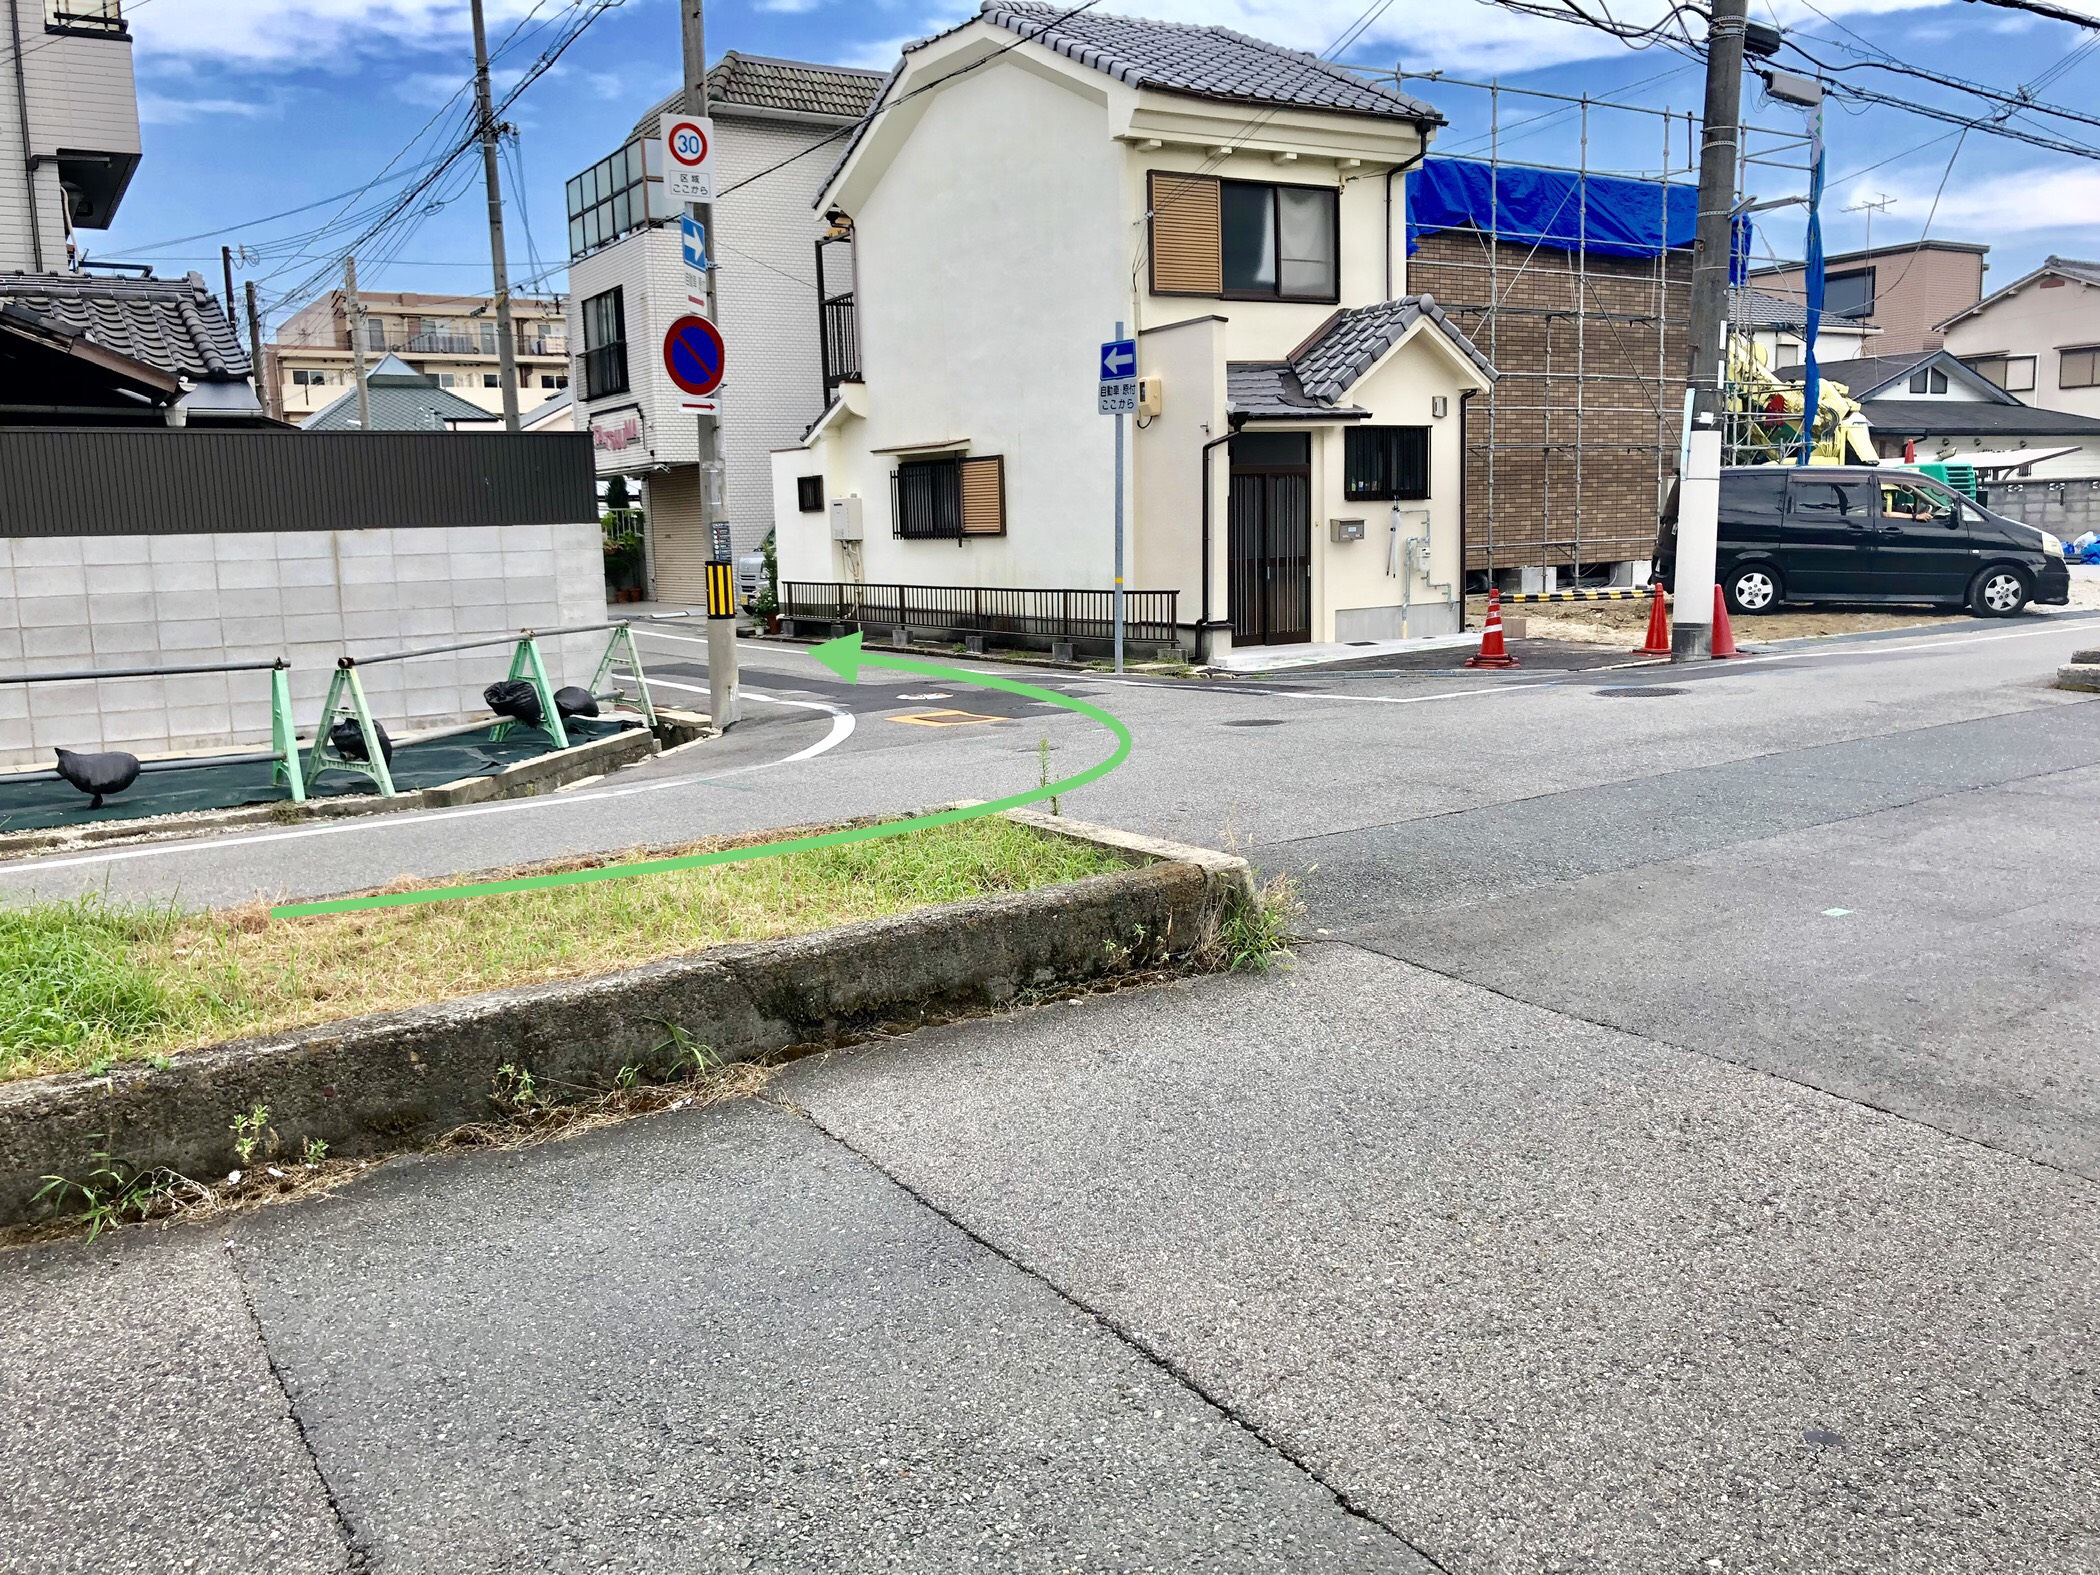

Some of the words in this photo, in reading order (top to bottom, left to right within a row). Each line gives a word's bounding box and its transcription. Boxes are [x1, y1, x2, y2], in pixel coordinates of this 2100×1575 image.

[677, 134, 700, 154] 30
[680, 173, 700, 184] 区域
[673, 183, 709, 195] ここから
[1102, 398, 1135, 410] ここから
